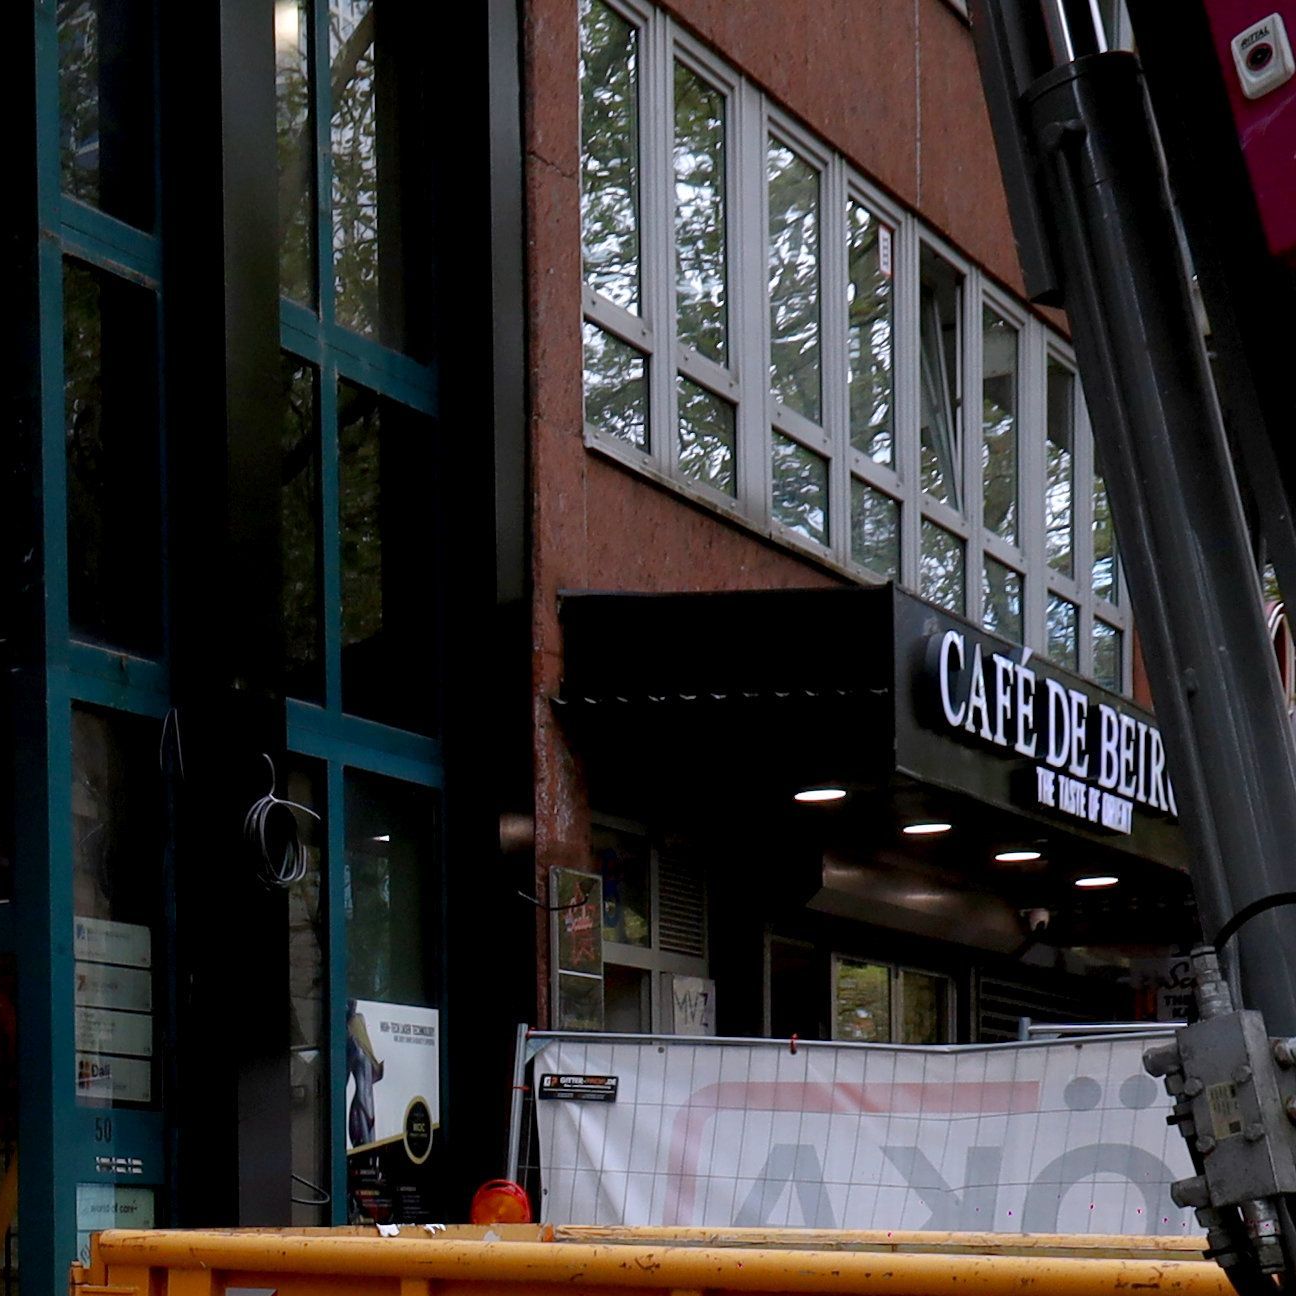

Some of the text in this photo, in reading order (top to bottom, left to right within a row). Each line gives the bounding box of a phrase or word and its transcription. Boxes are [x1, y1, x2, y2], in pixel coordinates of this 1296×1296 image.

[940, 630, 1179, 817] CAFÉ DE BEIR
[1036, 766, 1133, 835] THE TASTE OF ORIENT
